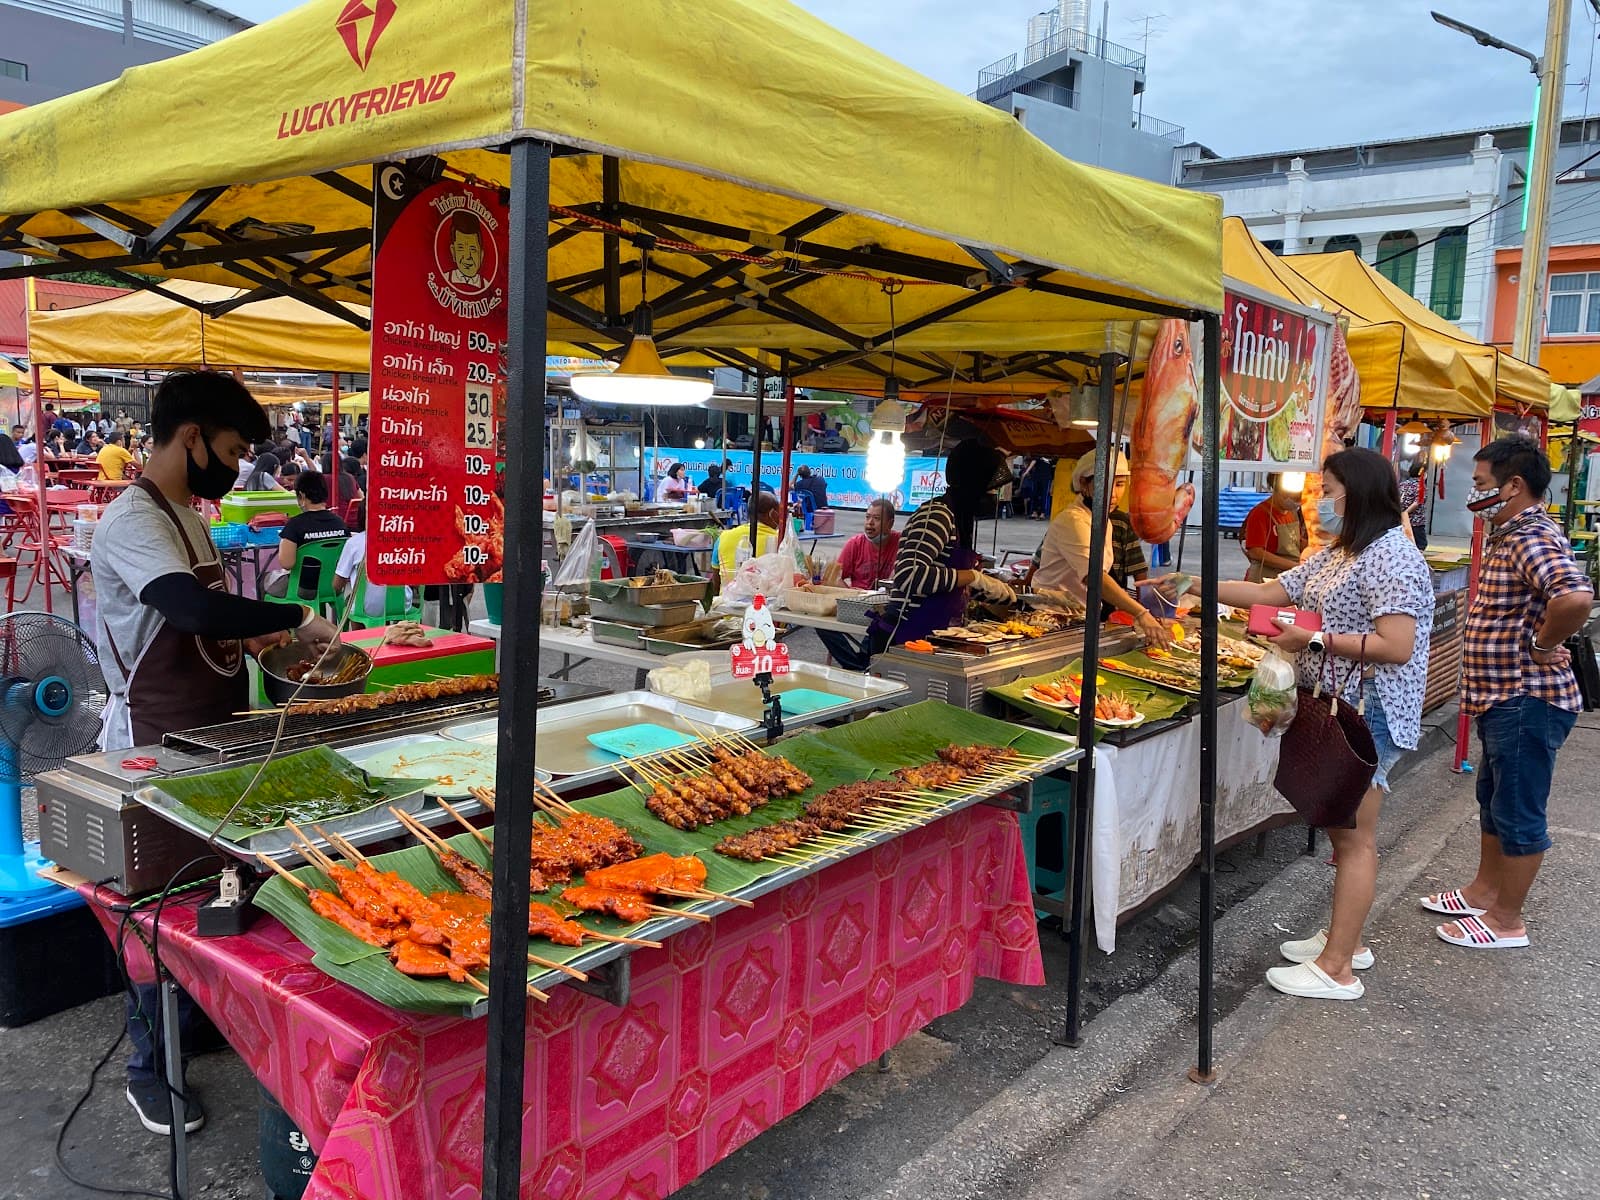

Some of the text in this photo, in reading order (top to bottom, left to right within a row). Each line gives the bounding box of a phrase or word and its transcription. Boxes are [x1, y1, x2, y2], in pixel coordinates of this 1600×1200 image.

[277, 71, 456, 139] LUCKYFRIEND
[383, 320, 496, 354] อกไก่ ใหญ่ 50.-
[1232, 302, 1290, 384] โกเล้ง
[381, 368, 410, 380] Chicken
[382, 353, 496, 384] อกไก่ เล็ก 20.-
[382, 384, 430, 405] น่องไก่
[380, 402, 410, 413] Chicken
[381, 417, 423, 437] ปีกไก่
[380, 450, 491, 475] ตับไก่ 10.-
[842, 467, 859, 479] 100
[380, 484, 490, 505] กะเพาะไก่ 10.-
[379, 515, 490, 534] ไส้ไก่ 10.-
[378, 546, 488, 565] หนังไก่ 10.-
[751, 655, 773, 676] 10
